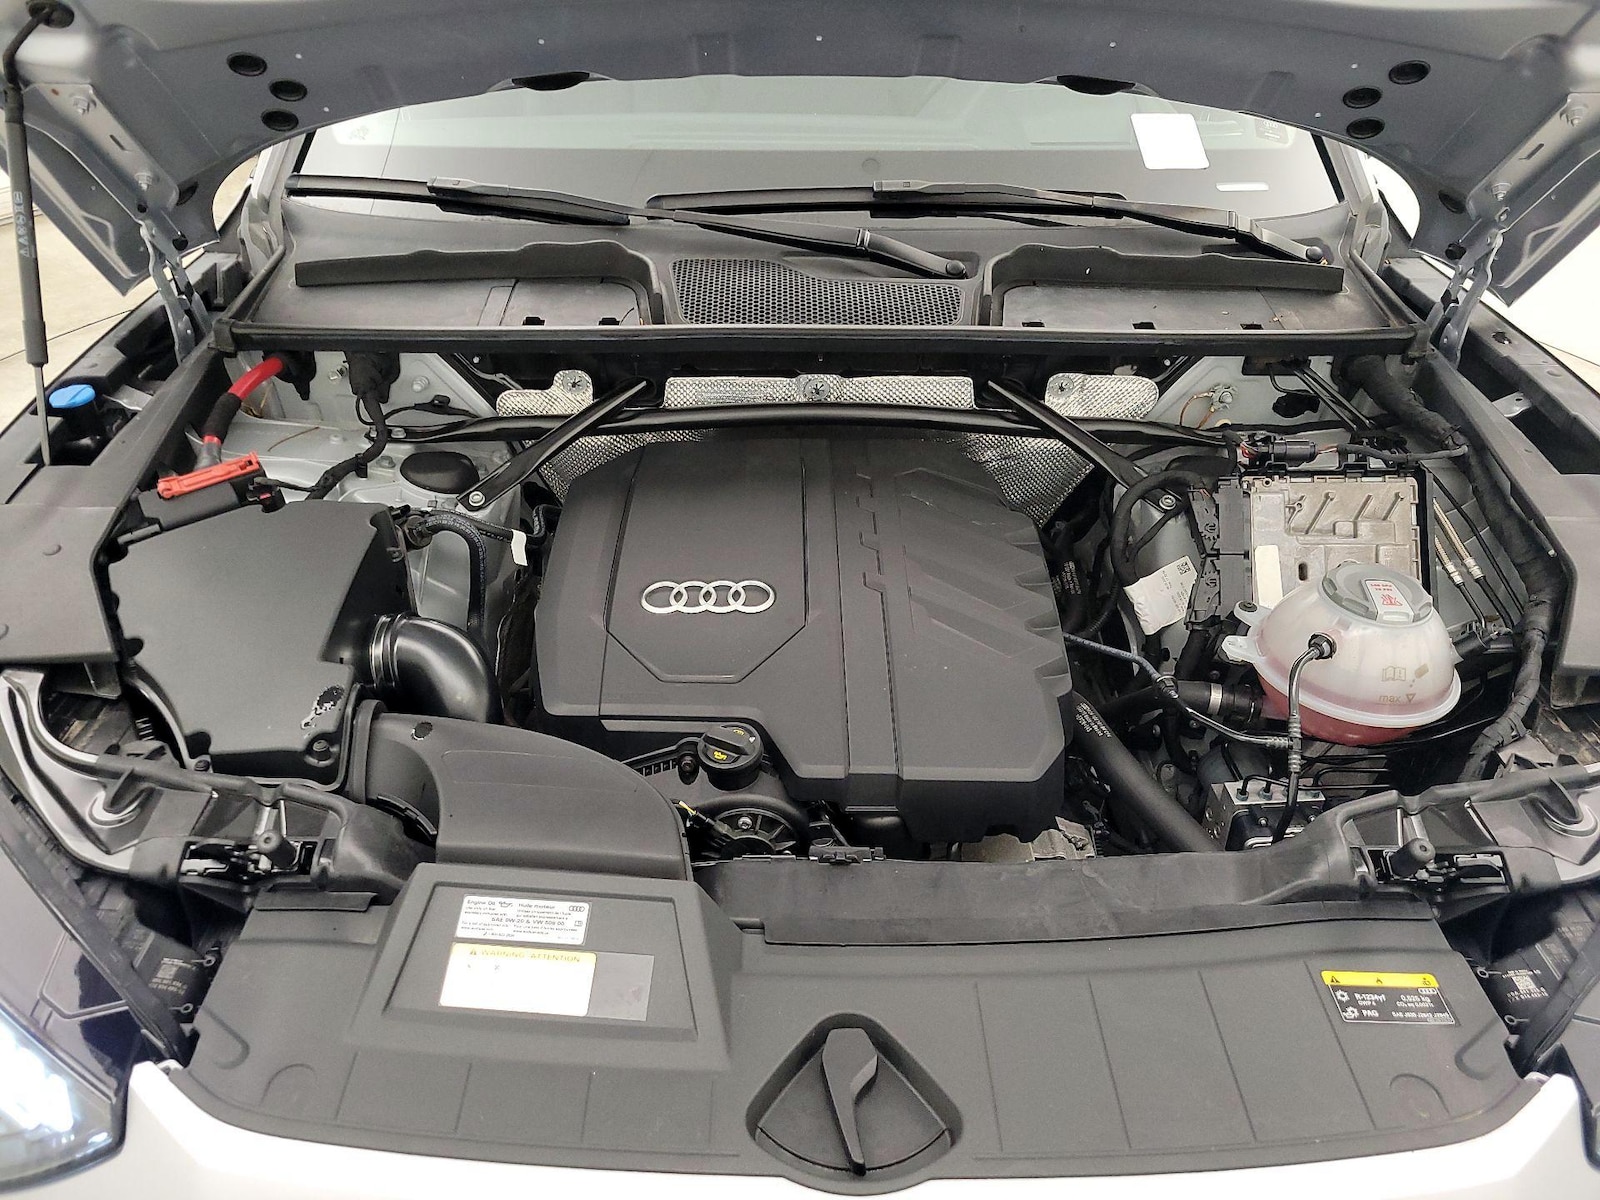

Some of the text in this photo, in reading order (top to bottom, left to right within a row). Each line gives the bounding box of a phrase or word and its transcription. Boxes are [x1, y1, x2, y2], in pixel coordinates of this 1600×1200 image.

[1378, 694, 1402, 704] max
[482, 948, 580, 963] WARNING ATTENTION
[1361, 1009, 1380, 1018] PAG
